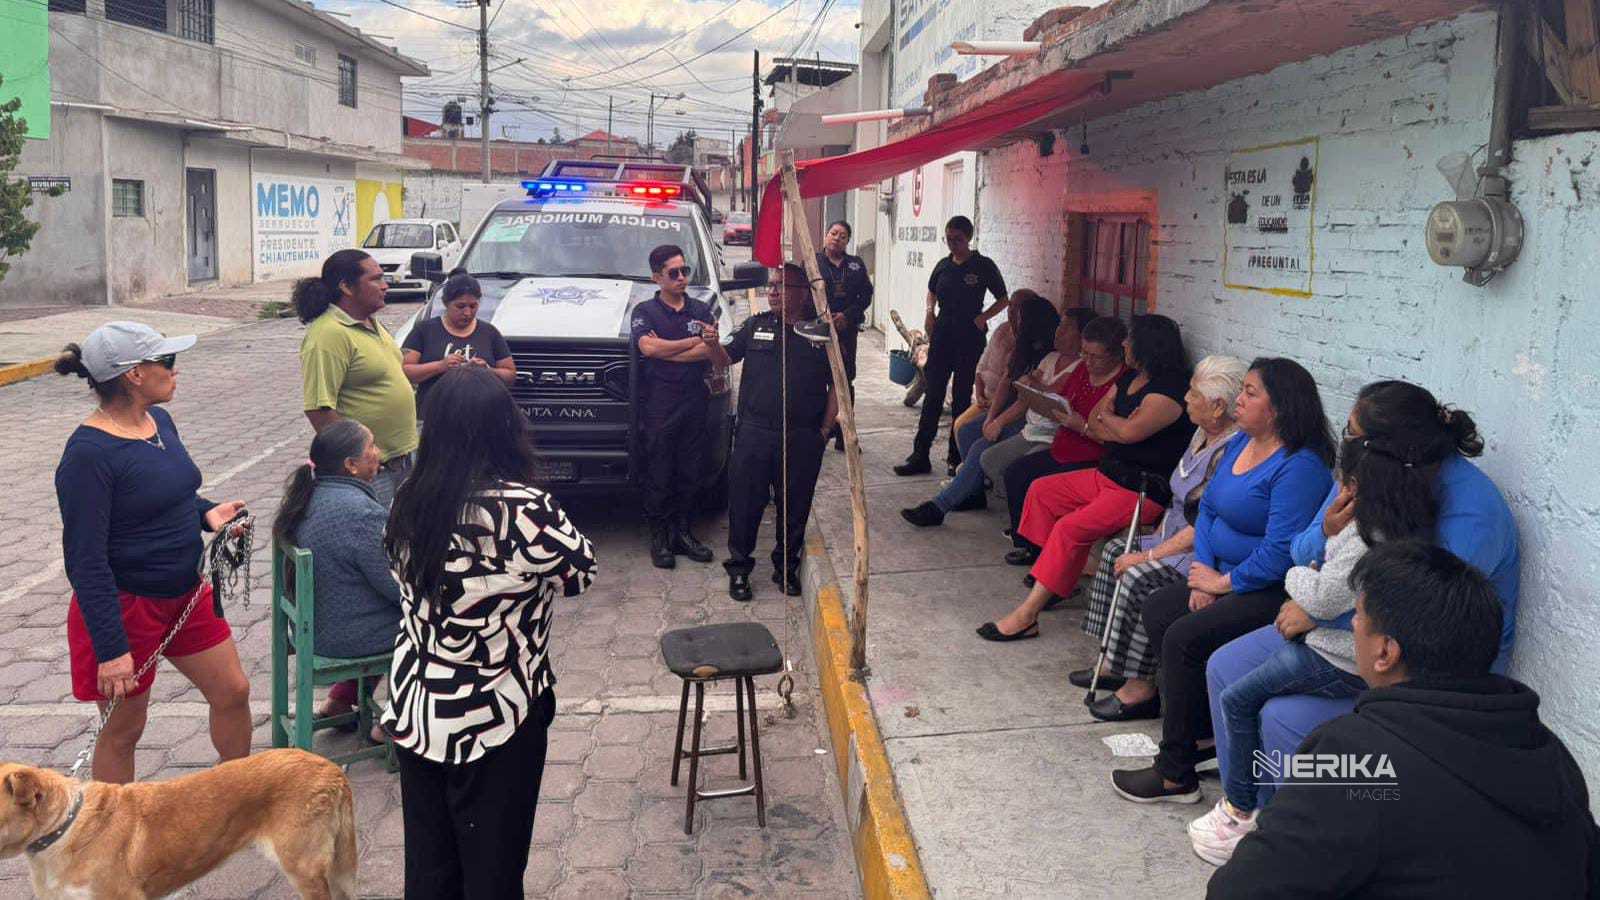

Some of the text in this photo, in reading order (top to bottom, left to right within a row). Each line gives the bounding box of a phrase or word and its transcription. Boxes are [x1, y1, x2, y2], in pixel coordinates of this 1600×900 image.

[256, 182, 319, 217] MEMO
[515, 371, 596, 385] RAM
[520, 407, 553, 417] NTA
